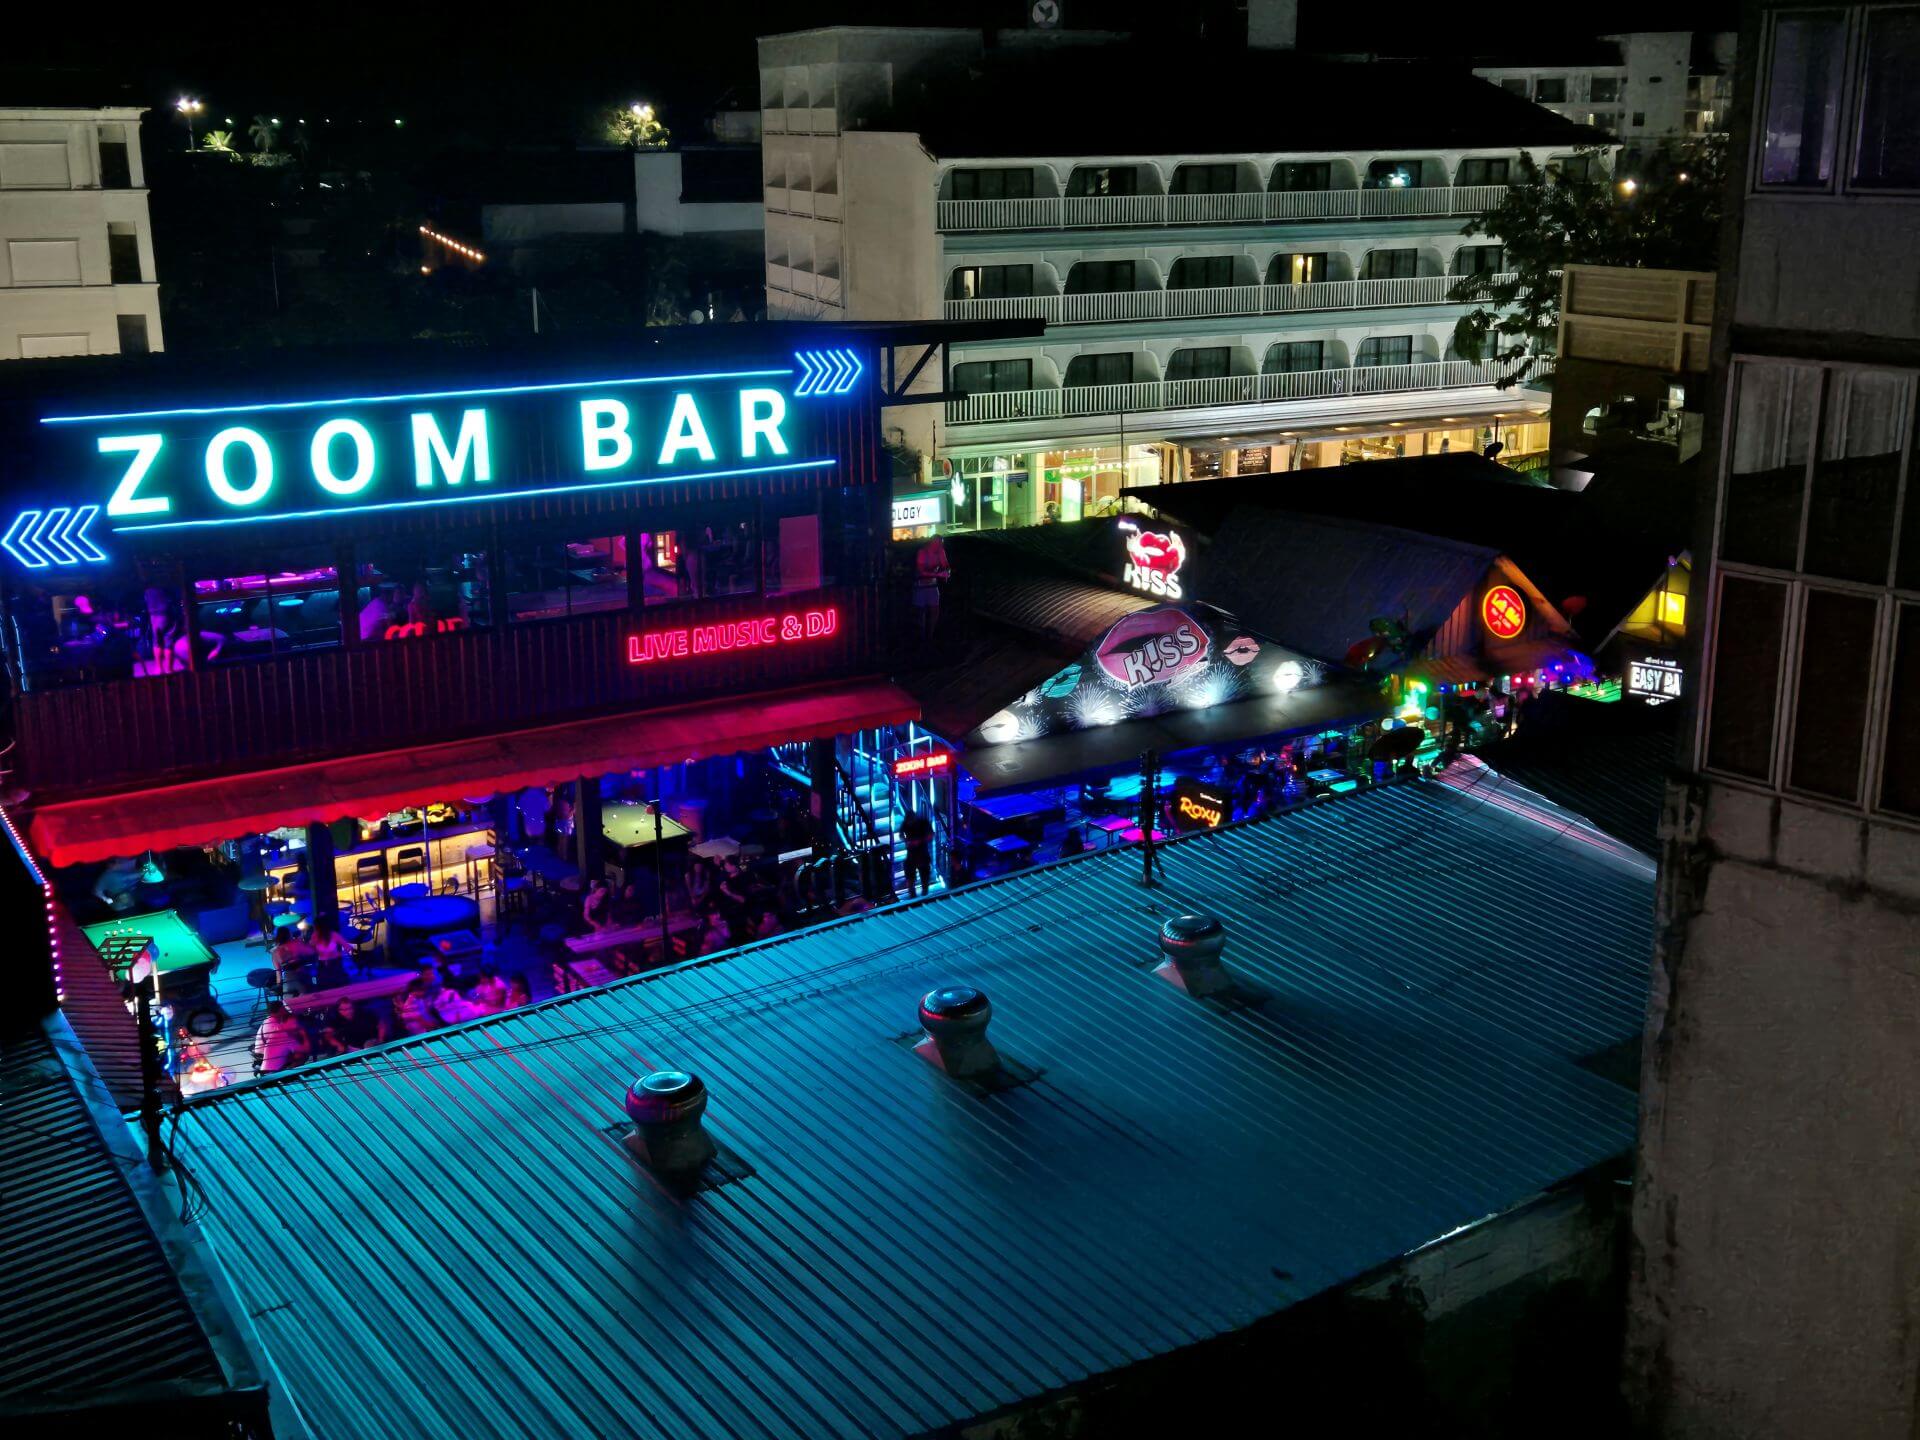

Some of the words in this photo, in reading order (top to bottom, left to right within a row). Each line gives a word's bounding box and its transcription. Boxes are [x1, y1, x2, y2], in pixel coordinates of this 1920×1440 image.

[97, 408, 492, 517] ZOOM
[580, 388, 790, 471] BAR
[628, 629, 688, 663] LIVE
[692, 617, 776, 654] MUSIC
[780, 615, 802, 641] &
[806, 608, 837, 637] DJ
[1630, 666, 1663, 691] EASY
